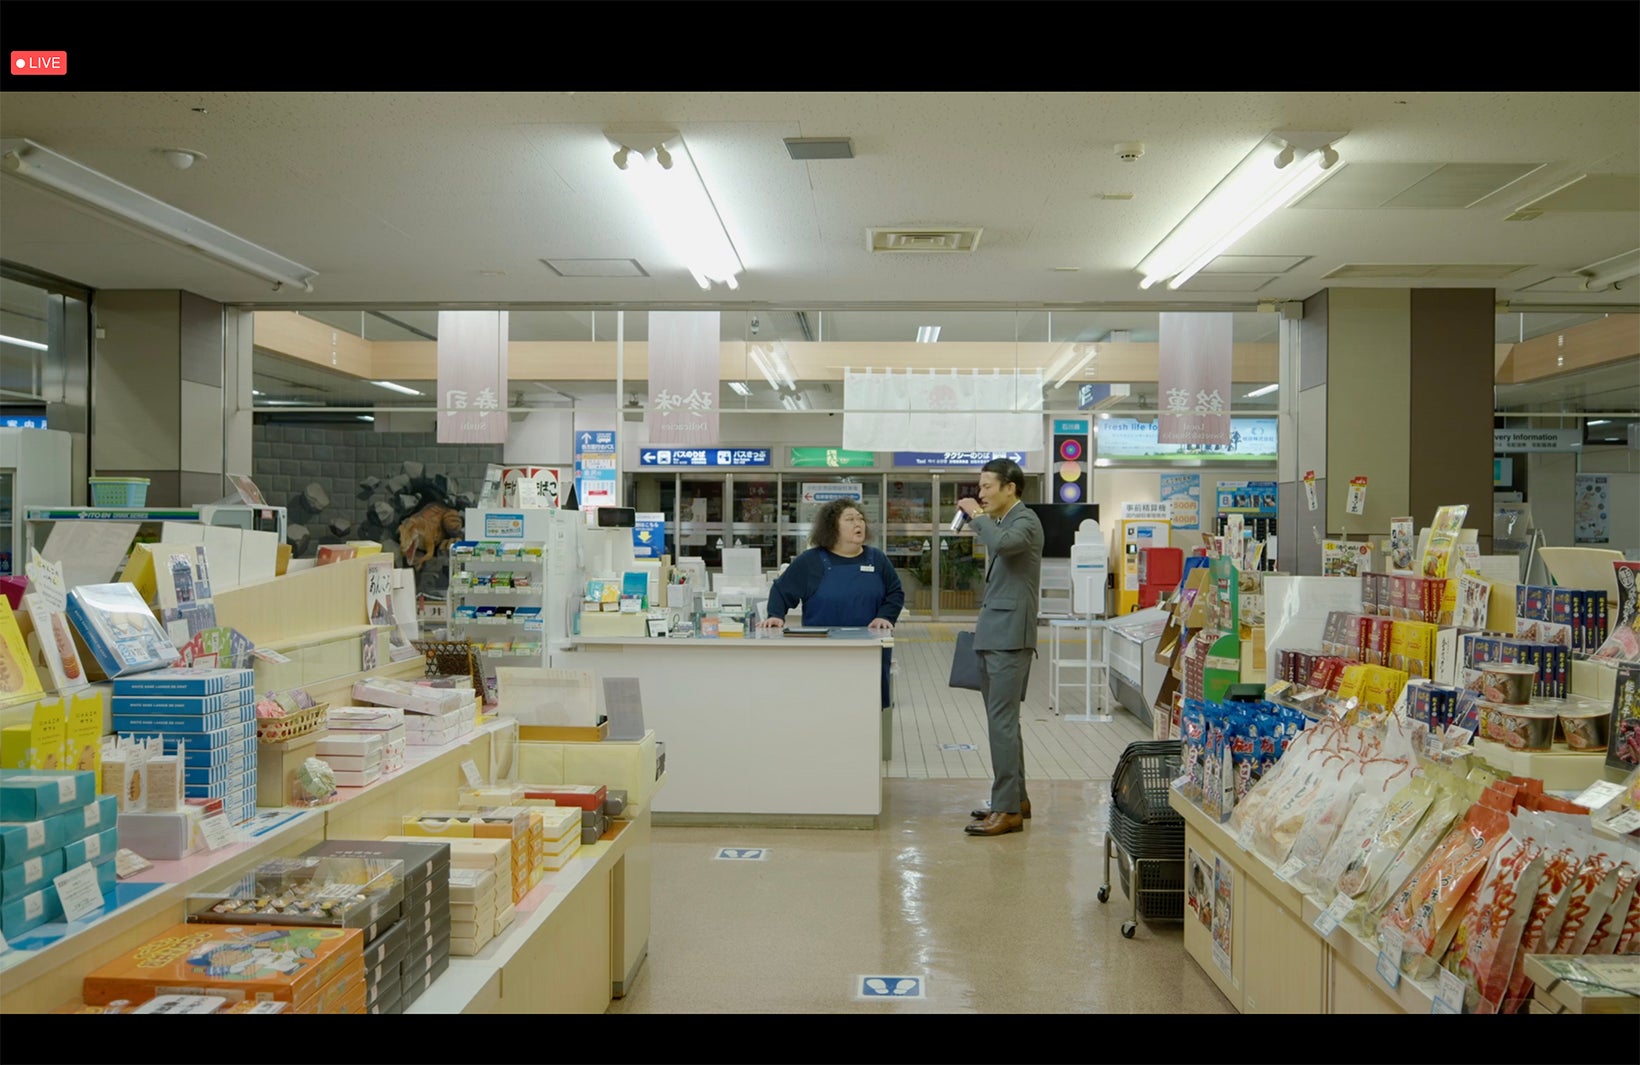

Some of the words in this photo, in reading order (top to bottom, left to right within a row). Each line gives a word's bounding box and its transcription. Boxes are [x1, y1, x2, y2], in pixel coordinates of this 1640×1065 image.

[1104, 423, 1128, 431] Fresh
[1131, 423, 1146, 431] life
[1148, 423, 1158, 431] fo
[1513, 433, 1558, 441] Information
[673, 450, 706, 458] バスのりば
[733, 450, 766, 458] バスきっぷ
